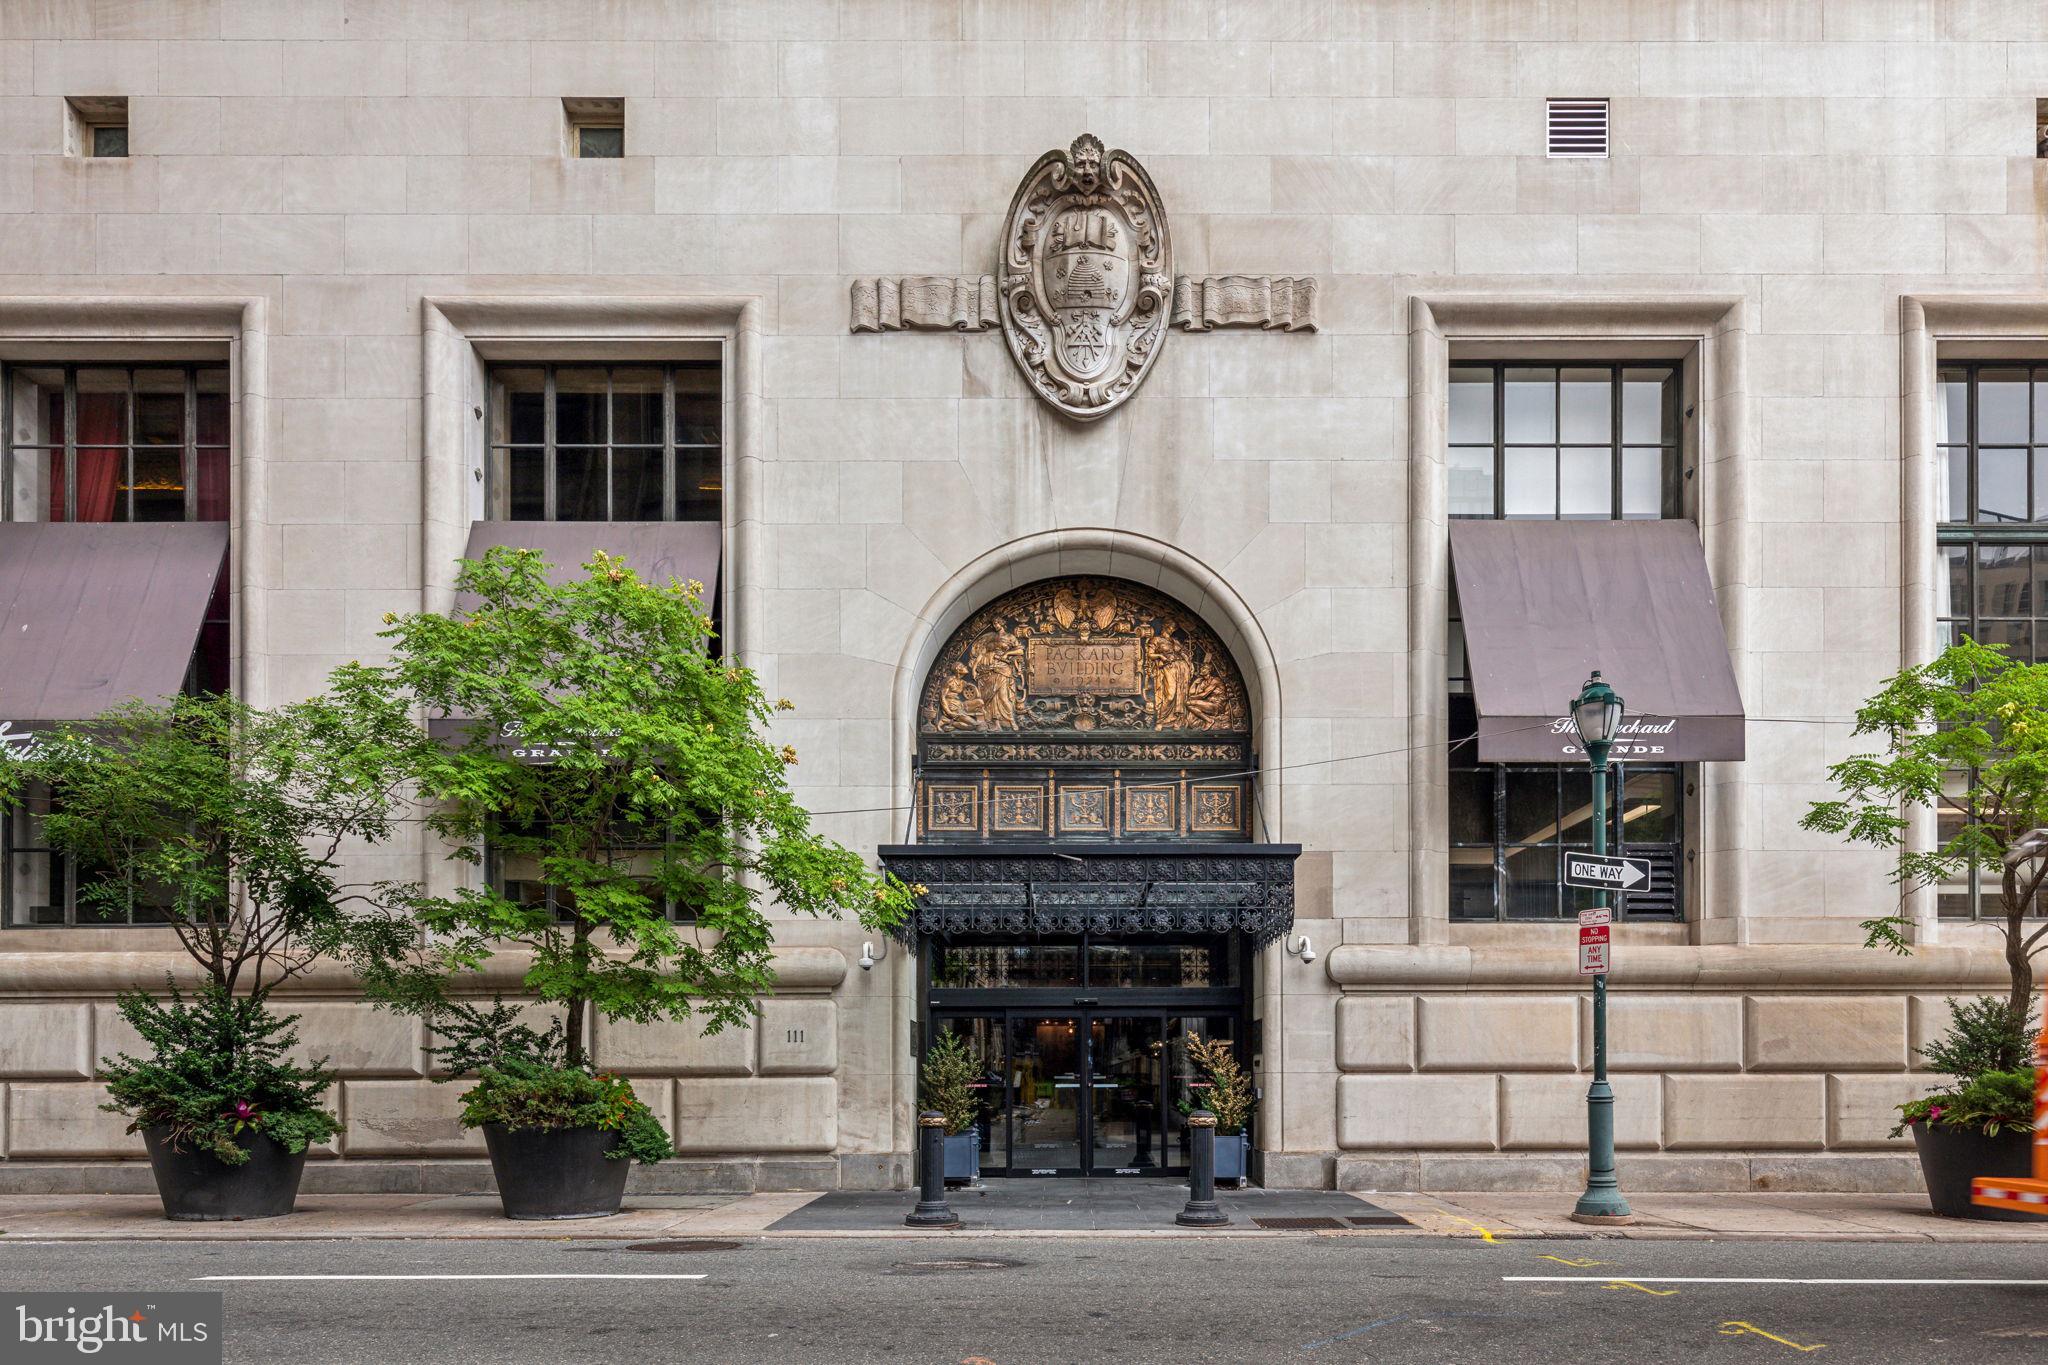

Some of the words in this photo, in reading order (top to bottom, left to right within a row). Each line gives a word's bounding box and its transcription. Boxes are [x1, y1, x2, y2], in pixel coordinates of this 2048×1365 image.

[1046, 647, 1124, 660] PACKARD
[1574, 863, 1596, 877] ONE
[1600, 866, 1623, 880] WAY
[1581, 935, 1607, 943] STOPPING
[1588, 945, 1601, 954] ANY
[1587, 955, 1602, 963] TIME
[787, 1030, 804, 1042] 111
